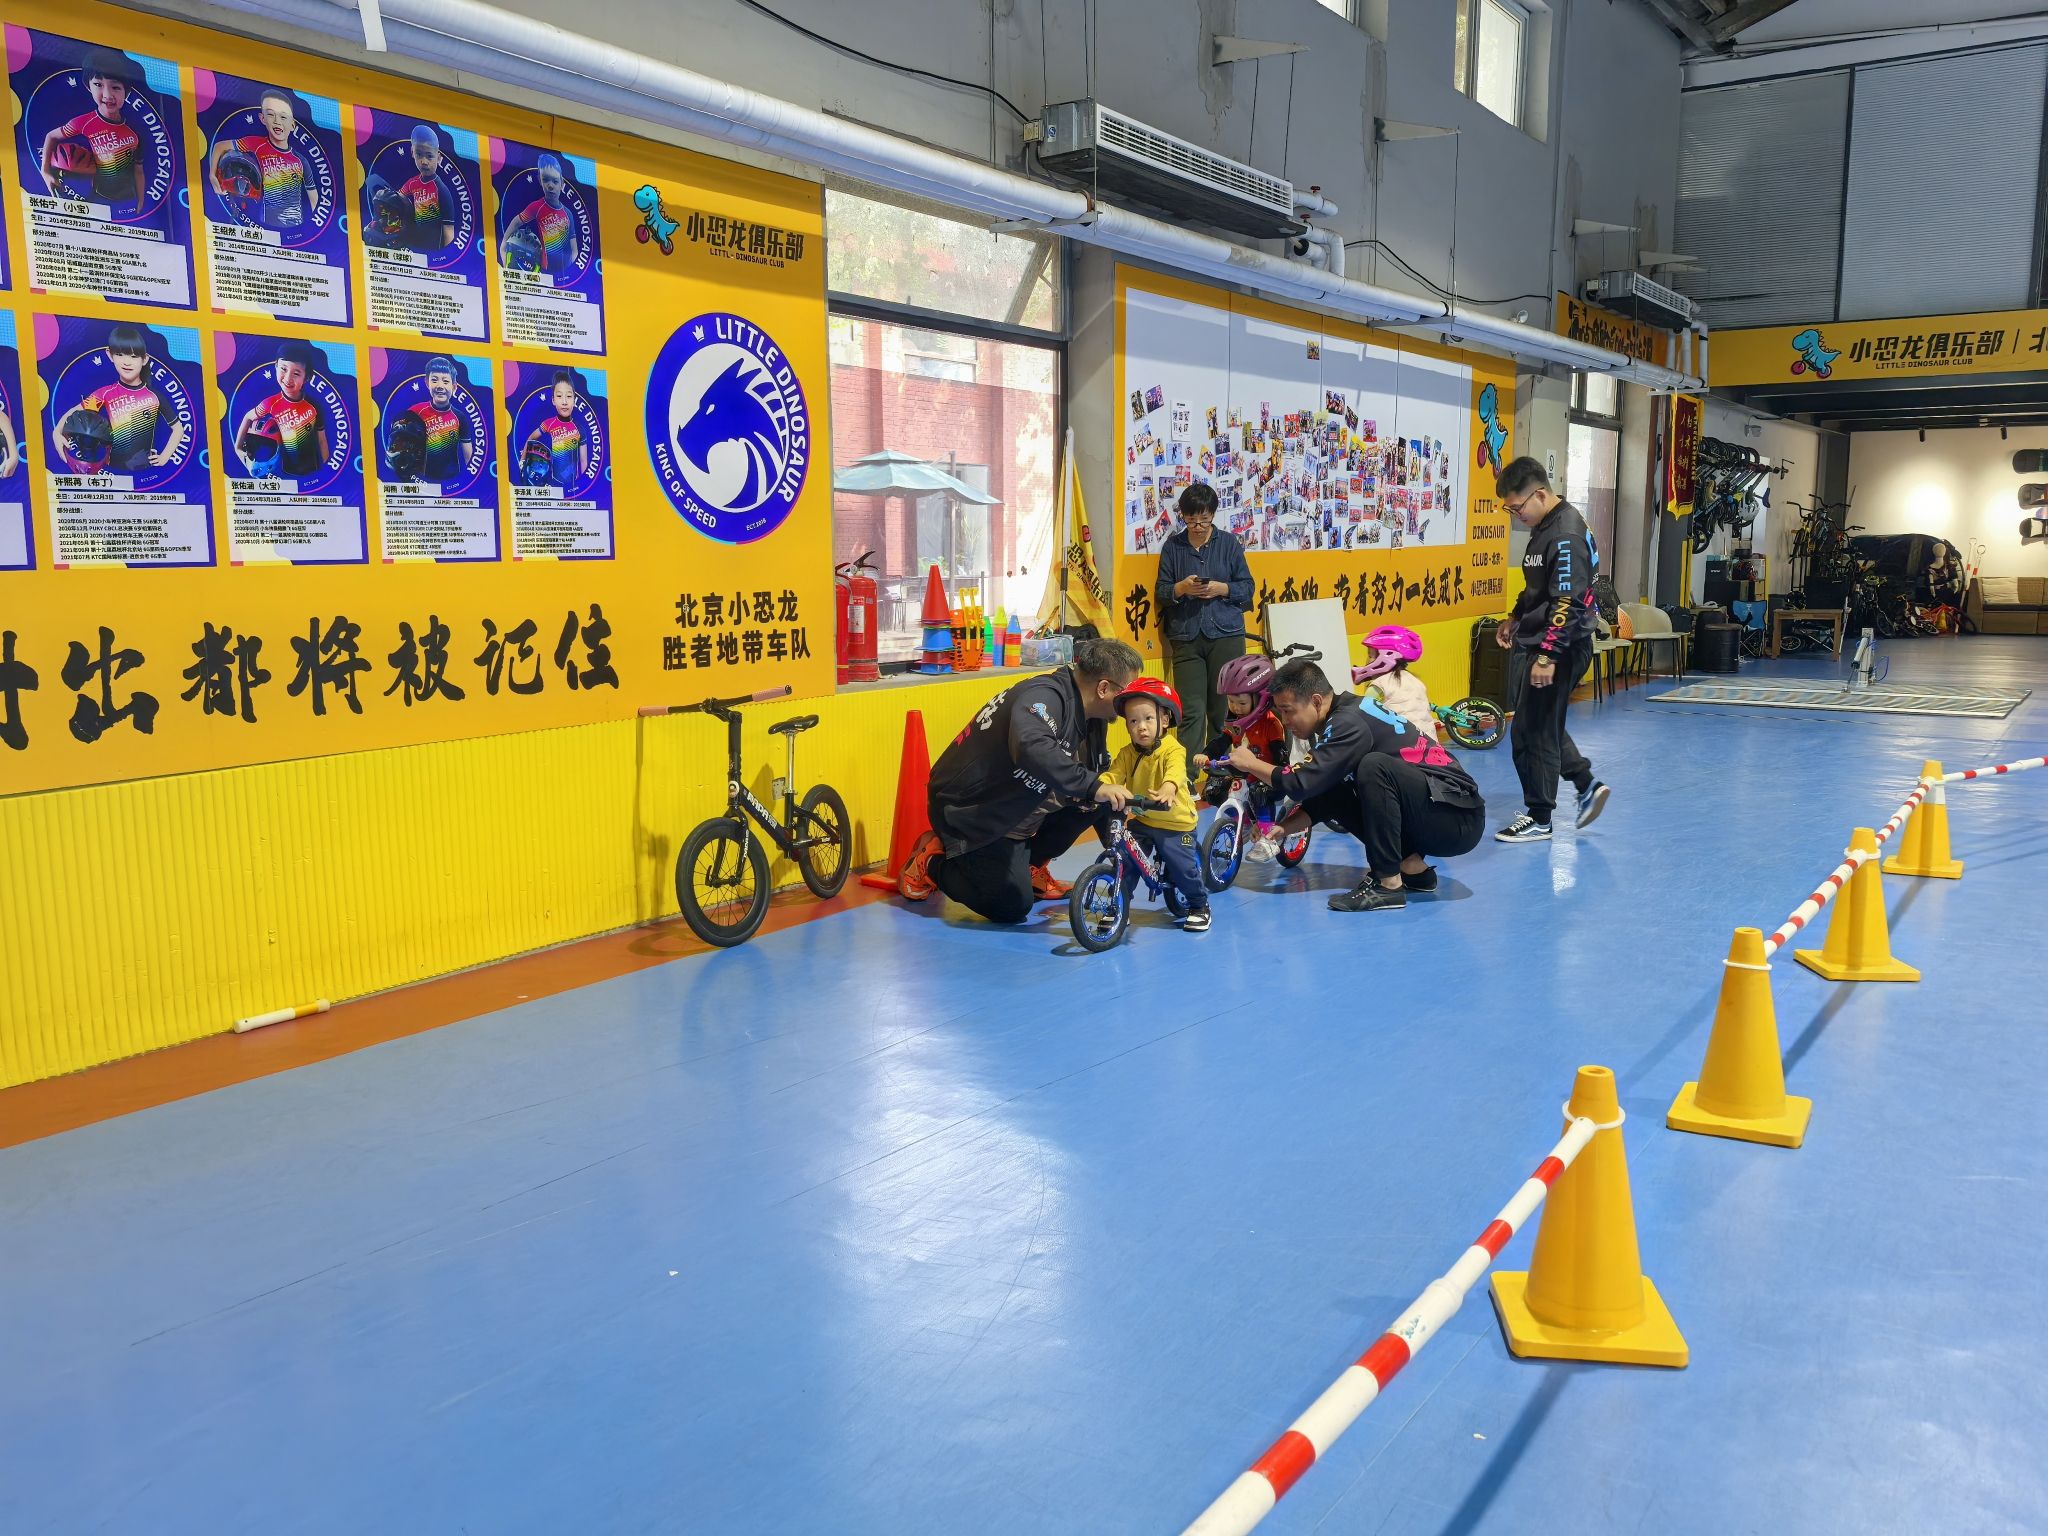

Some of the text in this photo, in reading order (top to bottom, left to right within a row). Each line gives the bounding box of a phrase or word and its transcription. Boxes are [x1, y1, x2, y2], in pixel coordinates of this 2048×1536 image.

[90, 132, 117, 147] LITTLE
[93, 136, 135, 154] DINOSAUR
[143, 113, 171, 201] DINOSAUR
[308, 146, 332, 227] DINOSAUR
[452, 175, 472, 250] DINOSAUR
[573, 201, 591, 270] DINOSAUR
[687, 212, 804, 261] 小恐龙俱乐部
[735, 253, 768, 264] DINOSAUR
[769, 259, 785, 268] CLUB
[1849, 330, 2005, 362] 小恐龙俱乐部
[1908, 359, 1950, 367] DINOSAUR
[716, 317, 805, 503] LITTLE DINOSAUR
[325, 393, 348, 471] DINOSAUR
[465, 403, 485, 475] DINOSAUR
[584, 411, 601, 480] DINOSAUR
[655, 443, 716, 528] KING OF SPEED
[1472, 525, 1505, 539] DINOSAUR
[1472, 552, 1488, 566] CLUB
[1524, 554, 1543, 566] SAUR
[1557, 540, 1571, 591] LITTLE
[1470, 577, 1503, 597] 小恐龙俱乐部
[675, 589, 798, 628] 北京小恐龙
[663, 627, 811, 671] 胜者地带车队
[1456, 701, 1468, 712] KID
[1485, 733, 1497, 743] KID
